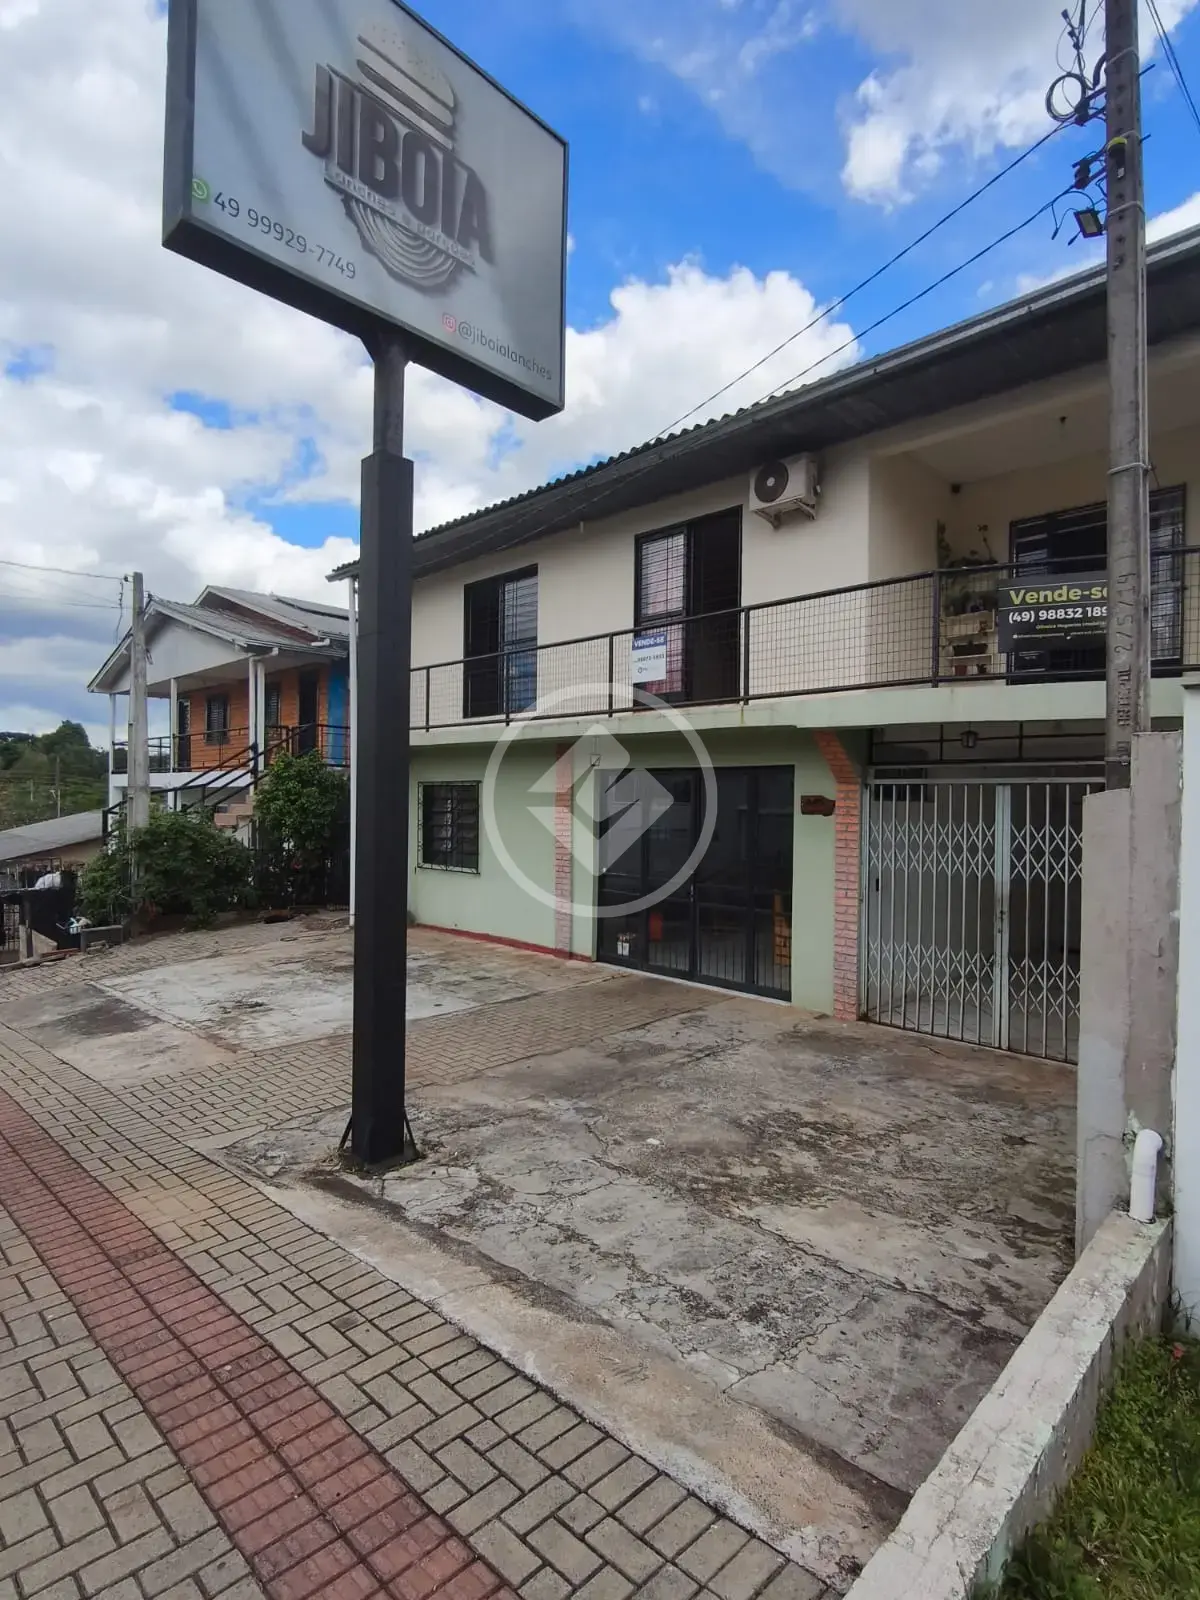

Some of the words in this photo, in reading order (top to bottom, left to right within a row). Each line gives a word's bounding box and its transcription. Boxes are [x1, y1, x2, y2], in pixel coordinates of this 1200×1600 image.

[302, 62, 495, 266] JIBOIA
[213, 192, 240, 218] 49
[247, 208, 356, 279] 99929-7749
[458, 321, 552, 380] @jiboialanches
[1009, 610, 1035, 624] (49)
[1038, 607, 1083, 620] 98832
